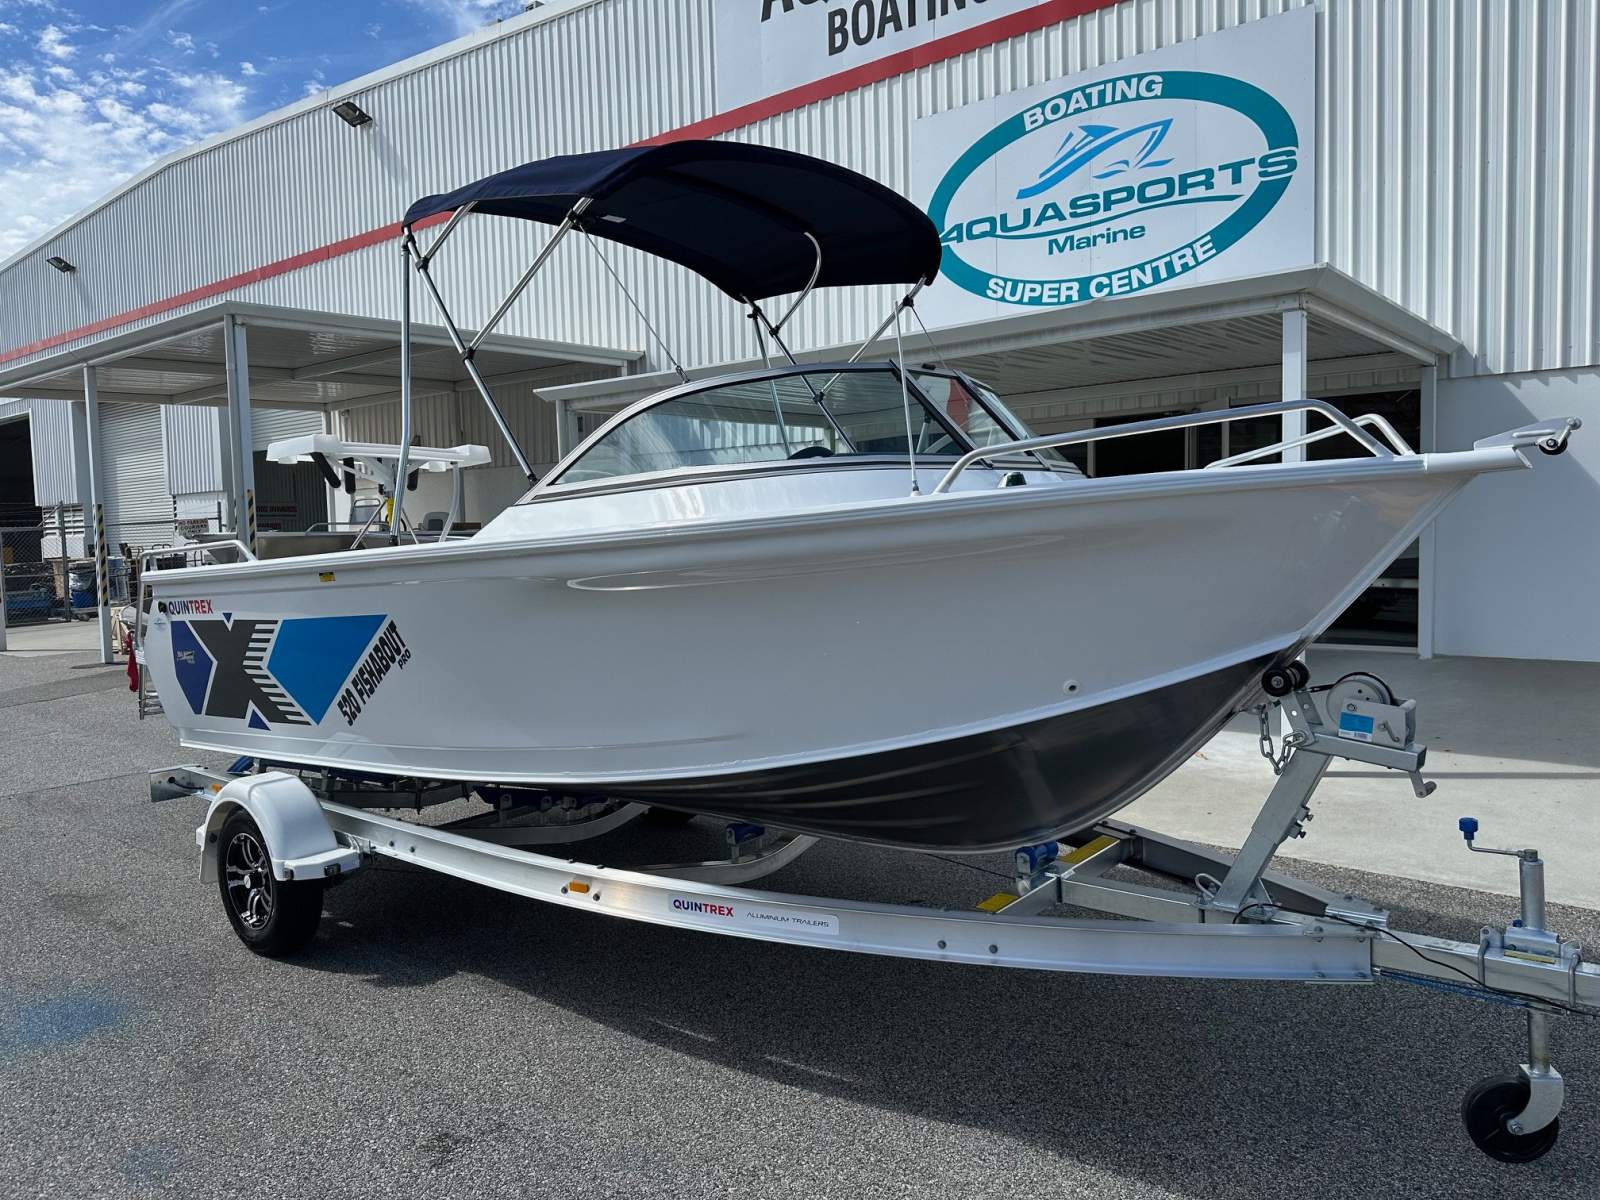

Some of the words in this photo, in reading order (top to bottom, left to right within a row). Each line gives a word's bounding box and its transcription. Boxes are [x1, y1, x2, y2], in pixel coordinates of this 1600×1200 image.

[828, 0, 988, 56] BOAT
[1023, 75, 1163, 132] BOATING
[940, 149, 1298, 245] AQUASPORTS
[1048, 225, 1146, 255] Marine
[986, 277, 1079, 303] SUPER
[1089, 235, 1217, 298] CENTRE
[168, 600, 213, 615] QUINTREX
[337, 688, 361, 726] 520
[352, 620, 406, 705] FISHABOUT
[398, 648, 411, 670] PRO
[673, 899, 734, 917] QUINTREX
[792, 918, 830, 928] TRAILERS
